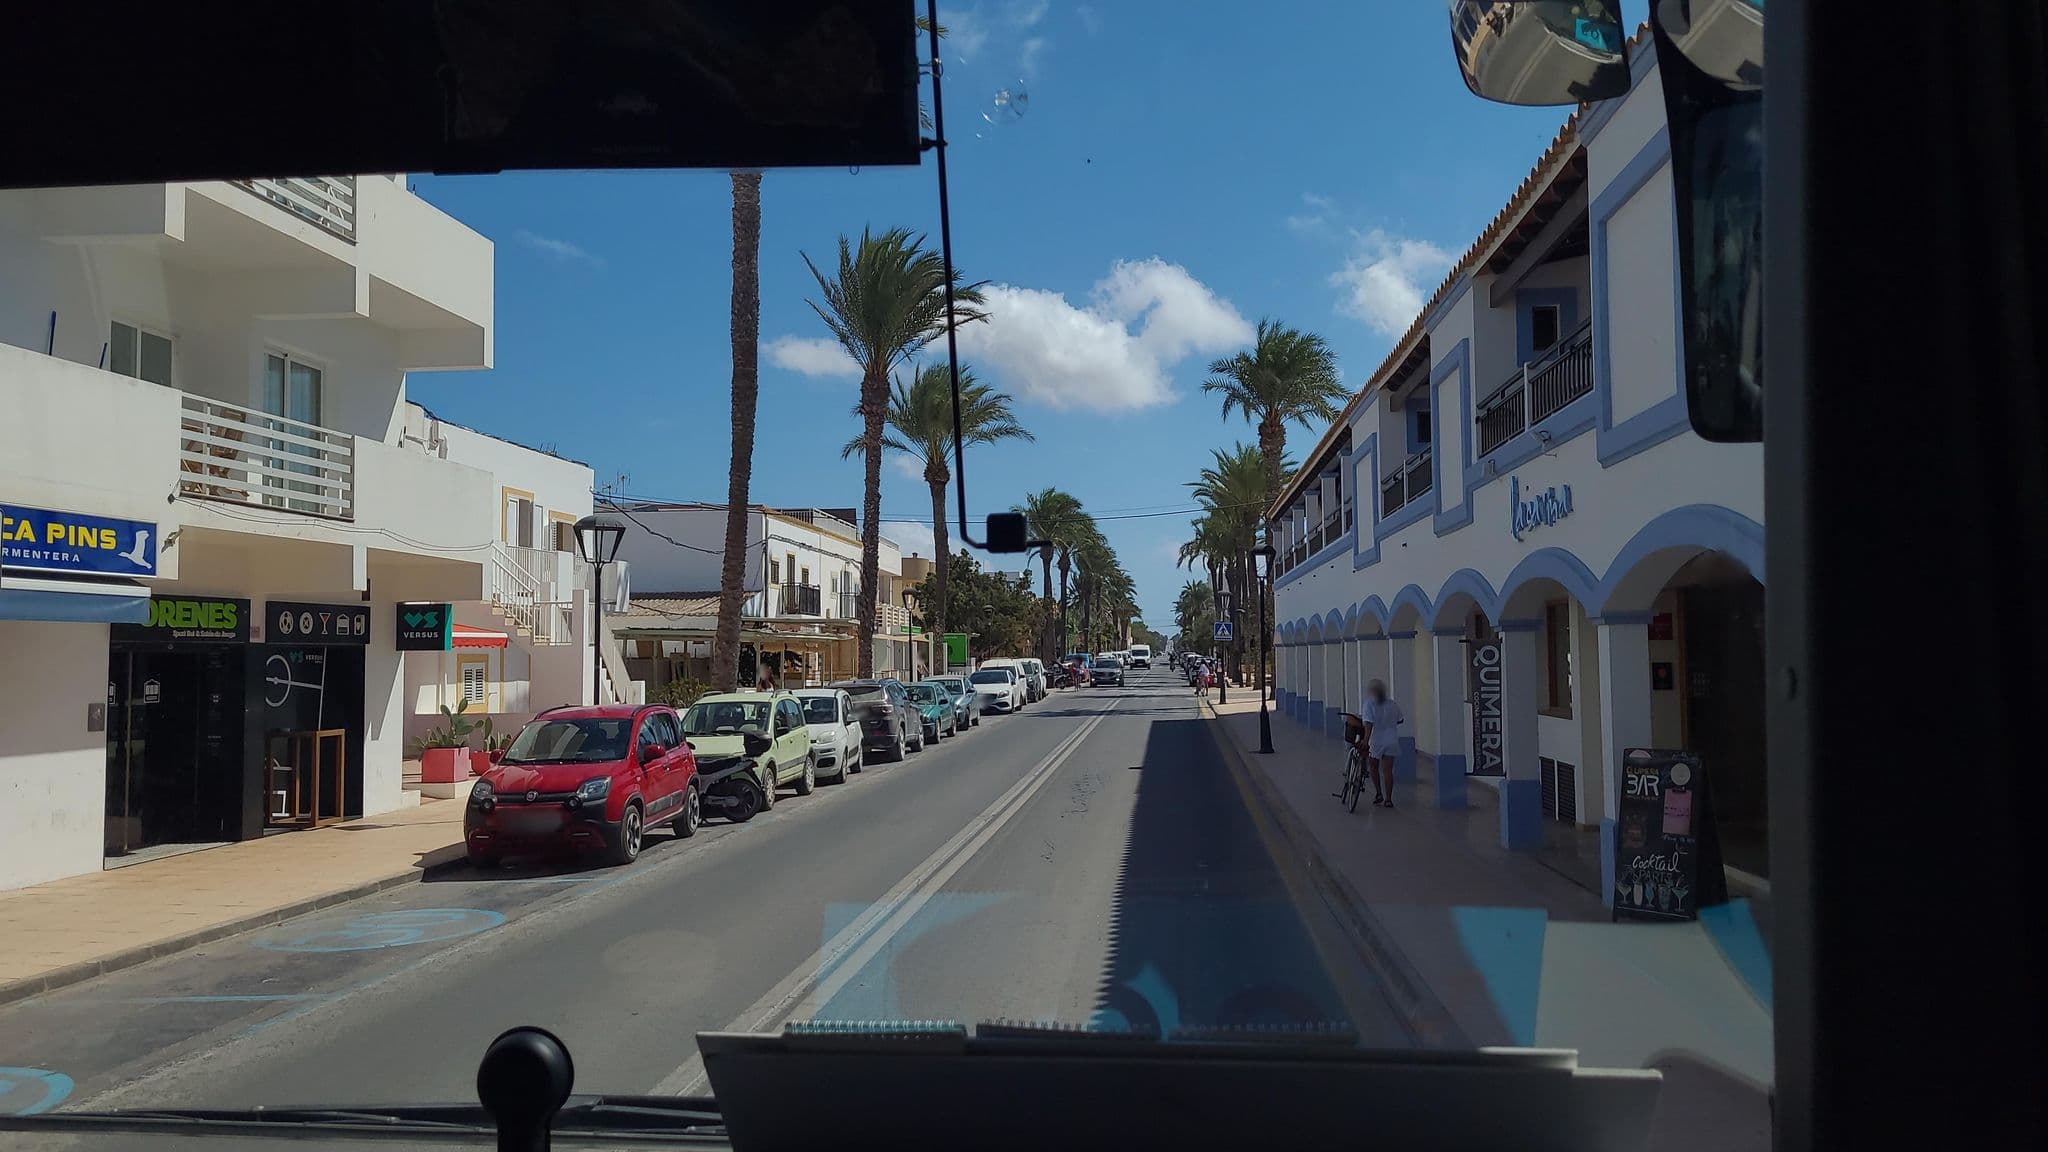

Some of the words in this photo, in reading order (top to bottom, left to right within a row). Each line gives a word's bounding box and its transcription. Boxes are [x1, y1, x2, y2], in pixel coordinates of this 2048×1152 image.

[46, 522, 118, 550] PINS
[403, 631, 439, 639] VERSUS
[1473, 645, 1502, 770] QUIMERA
[1626, 774, 1659, 797] BAR
[1632, 851, 1681, 873] Cocktail
